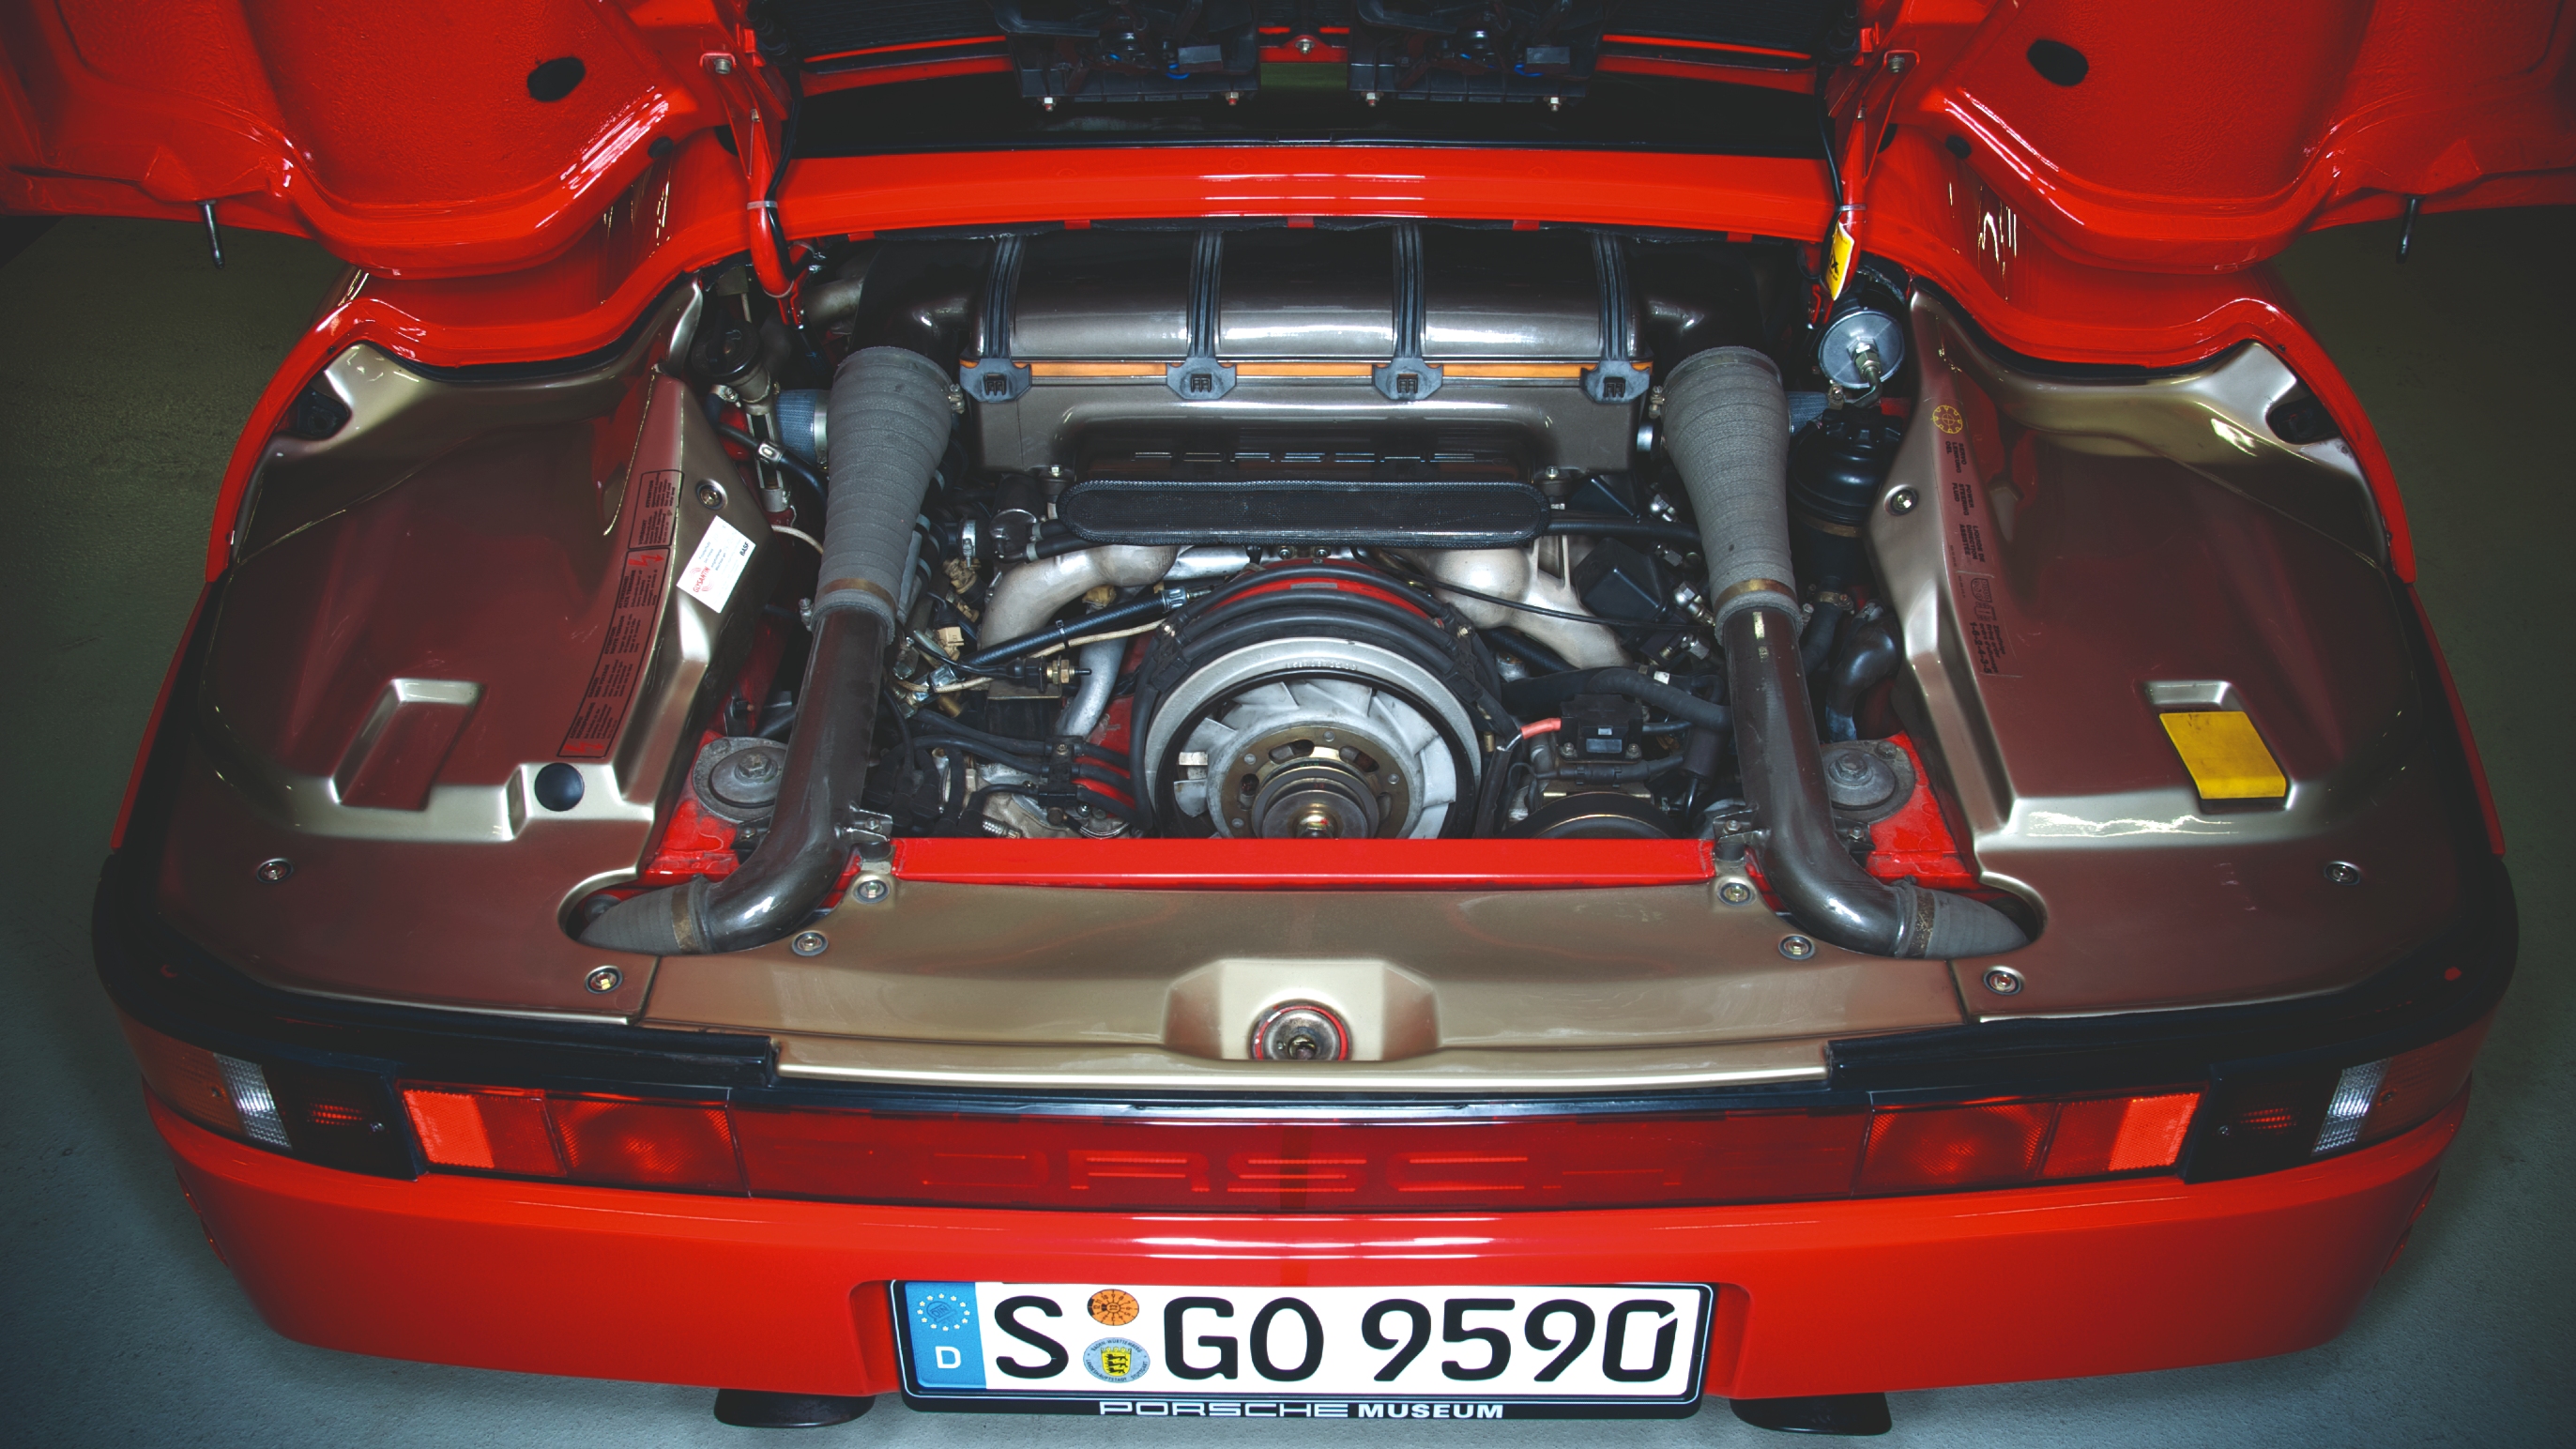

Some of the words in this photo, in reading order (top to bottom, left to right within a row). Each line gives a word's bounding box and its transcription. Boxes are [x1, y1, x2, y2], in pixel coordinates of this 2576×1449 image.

[1952, 441, 1962, 473] LENKUNG
[1959, 483, 1969, 515] STEERING
[1965, 484, 1974, 508] POWER
[739, 541, 749, 556] BASF
[1966, 525, 1977, 559] DIRECTION
[1973, 526, 1983, 551] LIQUIDE
[1978, 553, 1985, 561] DE
[693, 566, 709, 592] GLYSANTIN
[1970, 621, 1991, 673] 1-6-2-4-3-5
[995, 1295, 1069, 1379] S
[1164, 1296, 1324, 1381] GO
[1361, 1298, 1678, 1382] 9590
[936, 1346, 961, 1368] D
[1099, 1401, 1349, 1418] PORSCHE
[1358, 1403, 1503, 1418] MUSEUM
